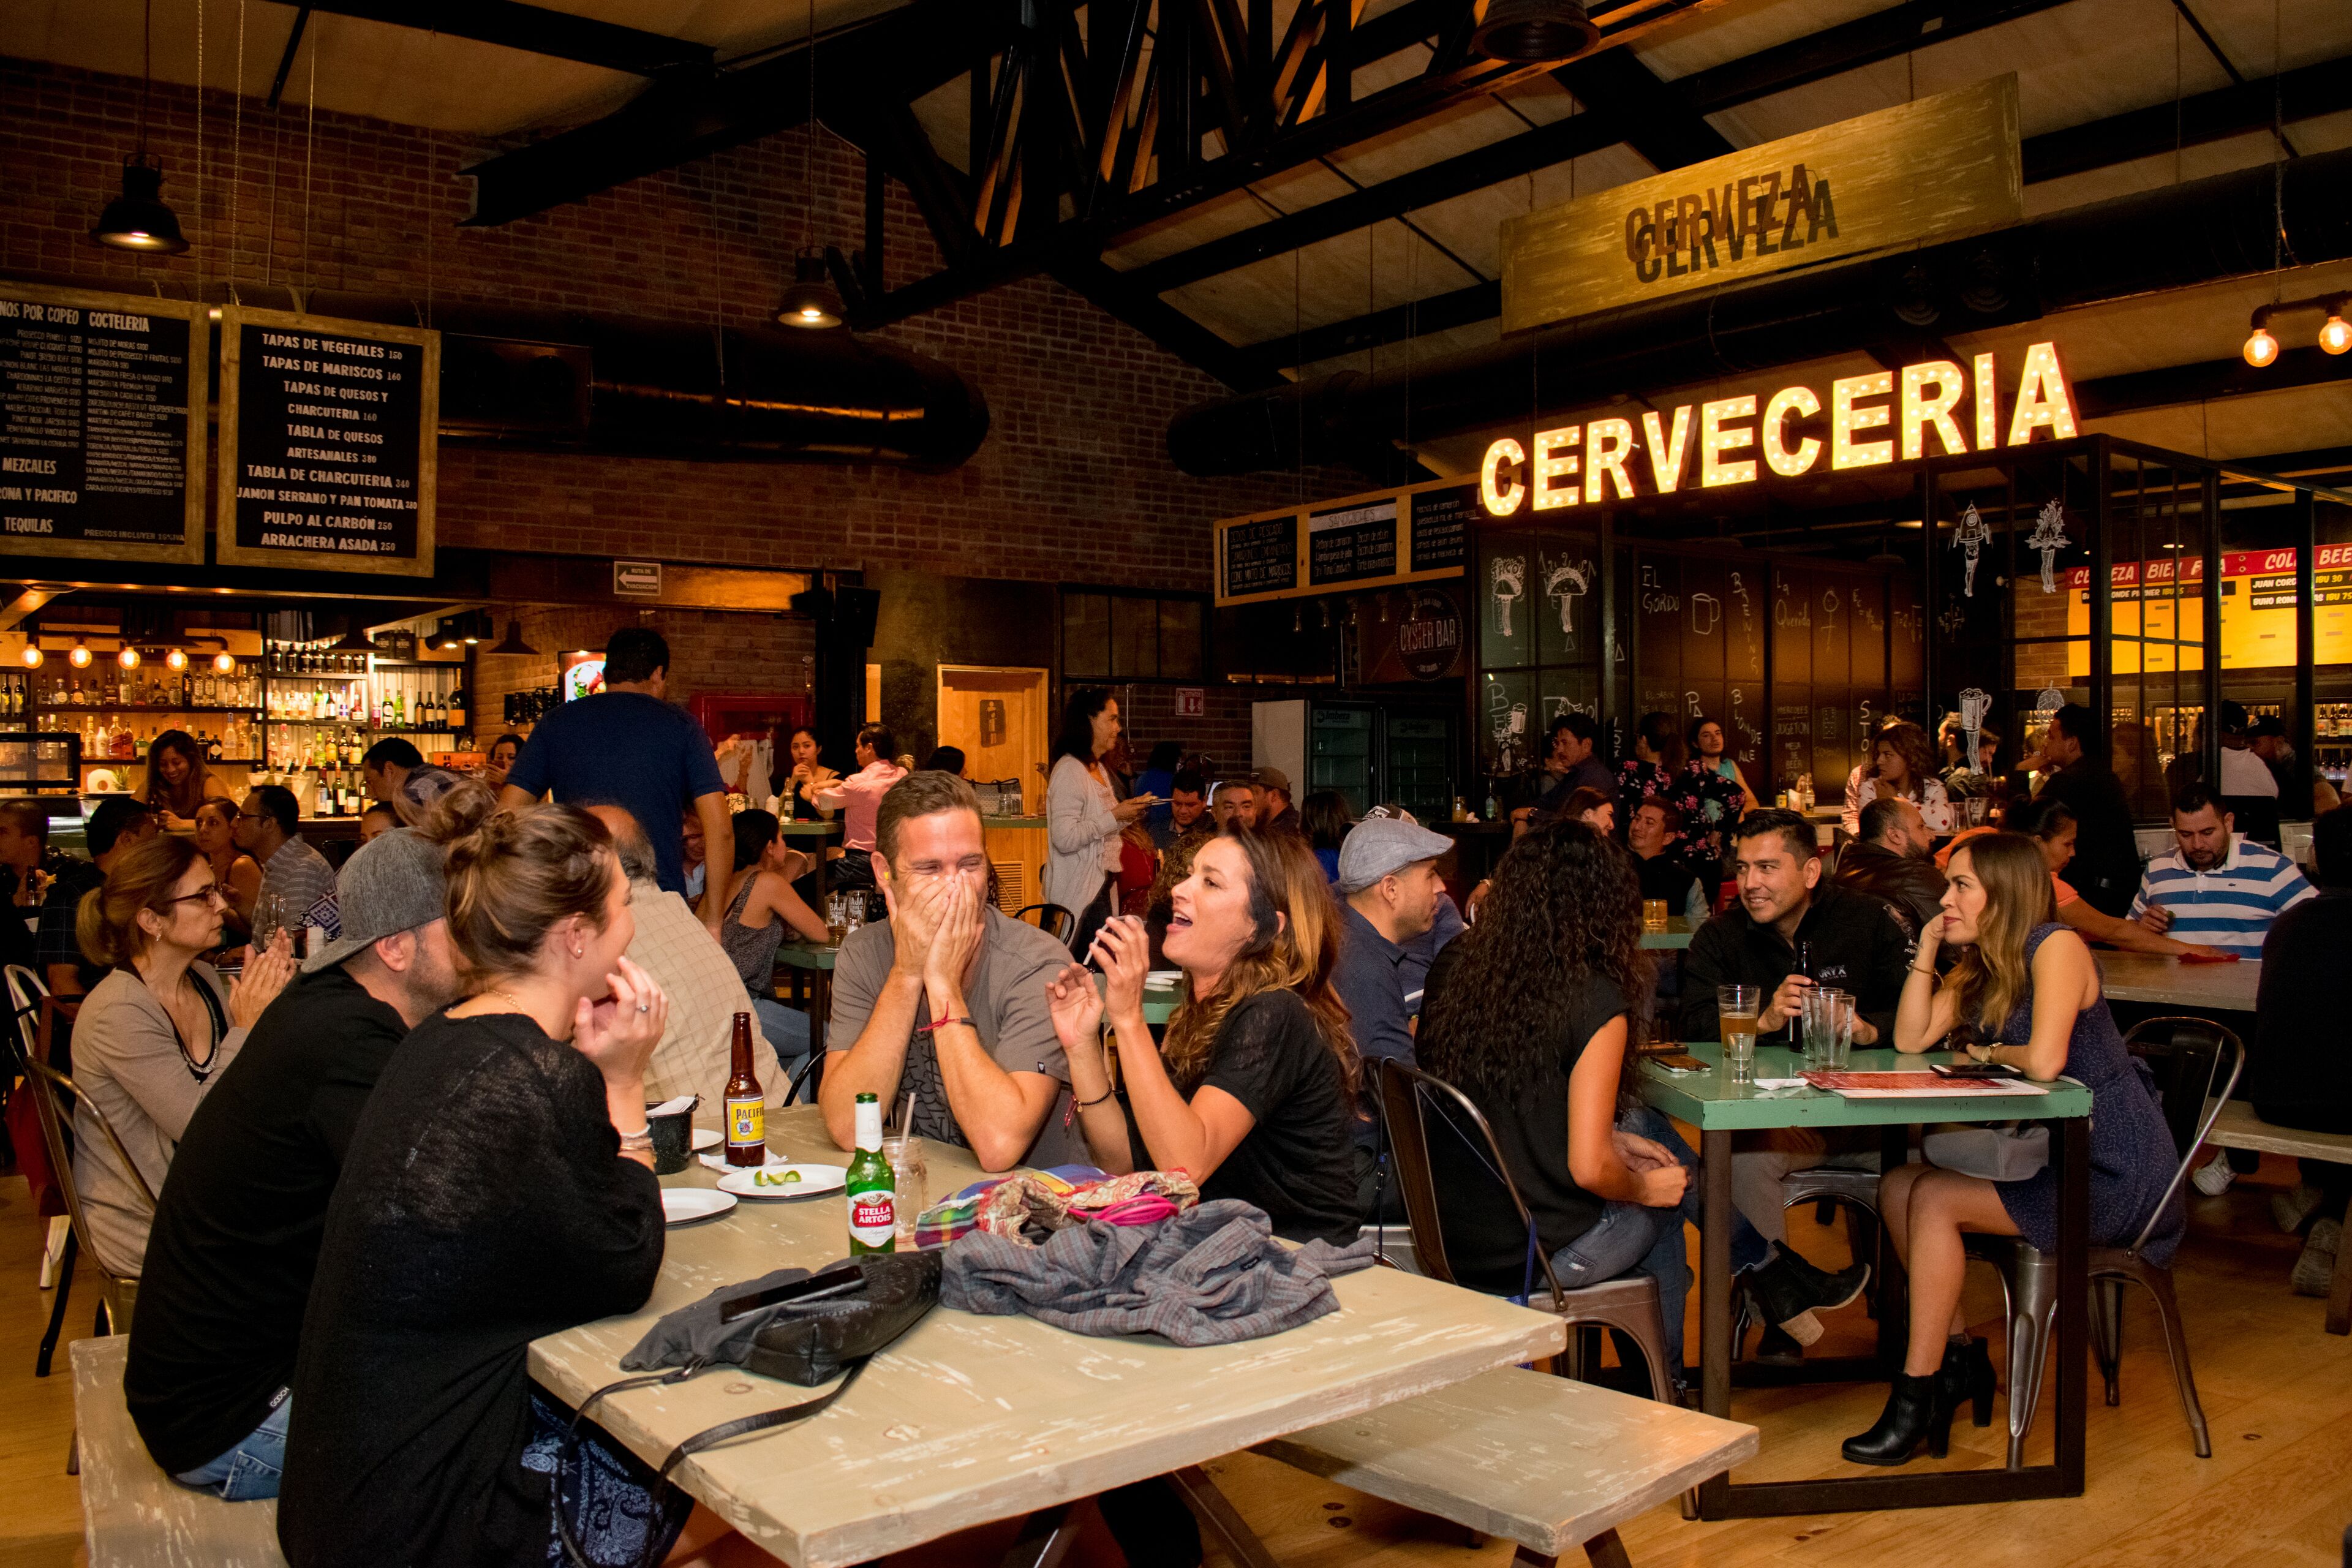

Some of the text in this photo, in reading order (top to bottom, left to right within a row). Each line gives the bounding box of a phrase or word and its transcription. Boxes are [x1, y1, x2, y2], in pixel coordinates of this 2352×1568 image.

[1626, 164, 1815, 263] CERVEZA
[23, 304, 43, 321] POR
[47, 307, 79, 325] COPEO
[89, 312, 150, 332] COCTELERIA
[262, 333, 402, 360] TAPAS DE VEGETALES 150
[263, 355, 401, 381] TAPAS DE MARISCOS 160
[284, 380, 388, 402] TAPAS DE QUESOS Y
[288, 403, 377, 421] CHARCUTERIA 160
[287, 424, 383, 445] TABLA DE QUESOS
[1480, 341, 2078, 516] CERVECERIA
[287, 447, 358, 463] ARTESANALES
[2, 458, 56, 474] MEZCALES
[247, 465, 410, 488] TABLA DE CHARCUTERIA 340
[24, 488, 32, 501] Y
[34, 488, 78, 504] PACIFICO
[236, 487, 275, 500] JAMON
[278, 490, 326, 504] SERRANO
[330, 494, 336, 504] Y
[341, 495, 361, 507] PAN
[364, 497, 404, 510] TOMATA
[4, 517, 53, 533] TEQUILAS
[264, 511, 303, 526] PULPO
[307, 514, 322, 526] AL
[378, 522, 392, 530] 250
[261, 533, 396, 551] ARRACHERA ASADA 250
[2265, 552, 2296, 570] COL
[1642, 566, 1661, 588] EL
[2074, 565, 2134, 585] CEEZA
[2253, 579, 2275, 588] JUAN
[1643, 593, 1680, 614] GORDO
[2253, 597, 2275, 606] BUHO
[1400, 618, 1456, 652] OYSTER BAR
[1738, 750, 1755, 763] ALE
[859, 1206, 891, 1216] STELLA
[859, 1214, 891, 1224] ARTOIS
